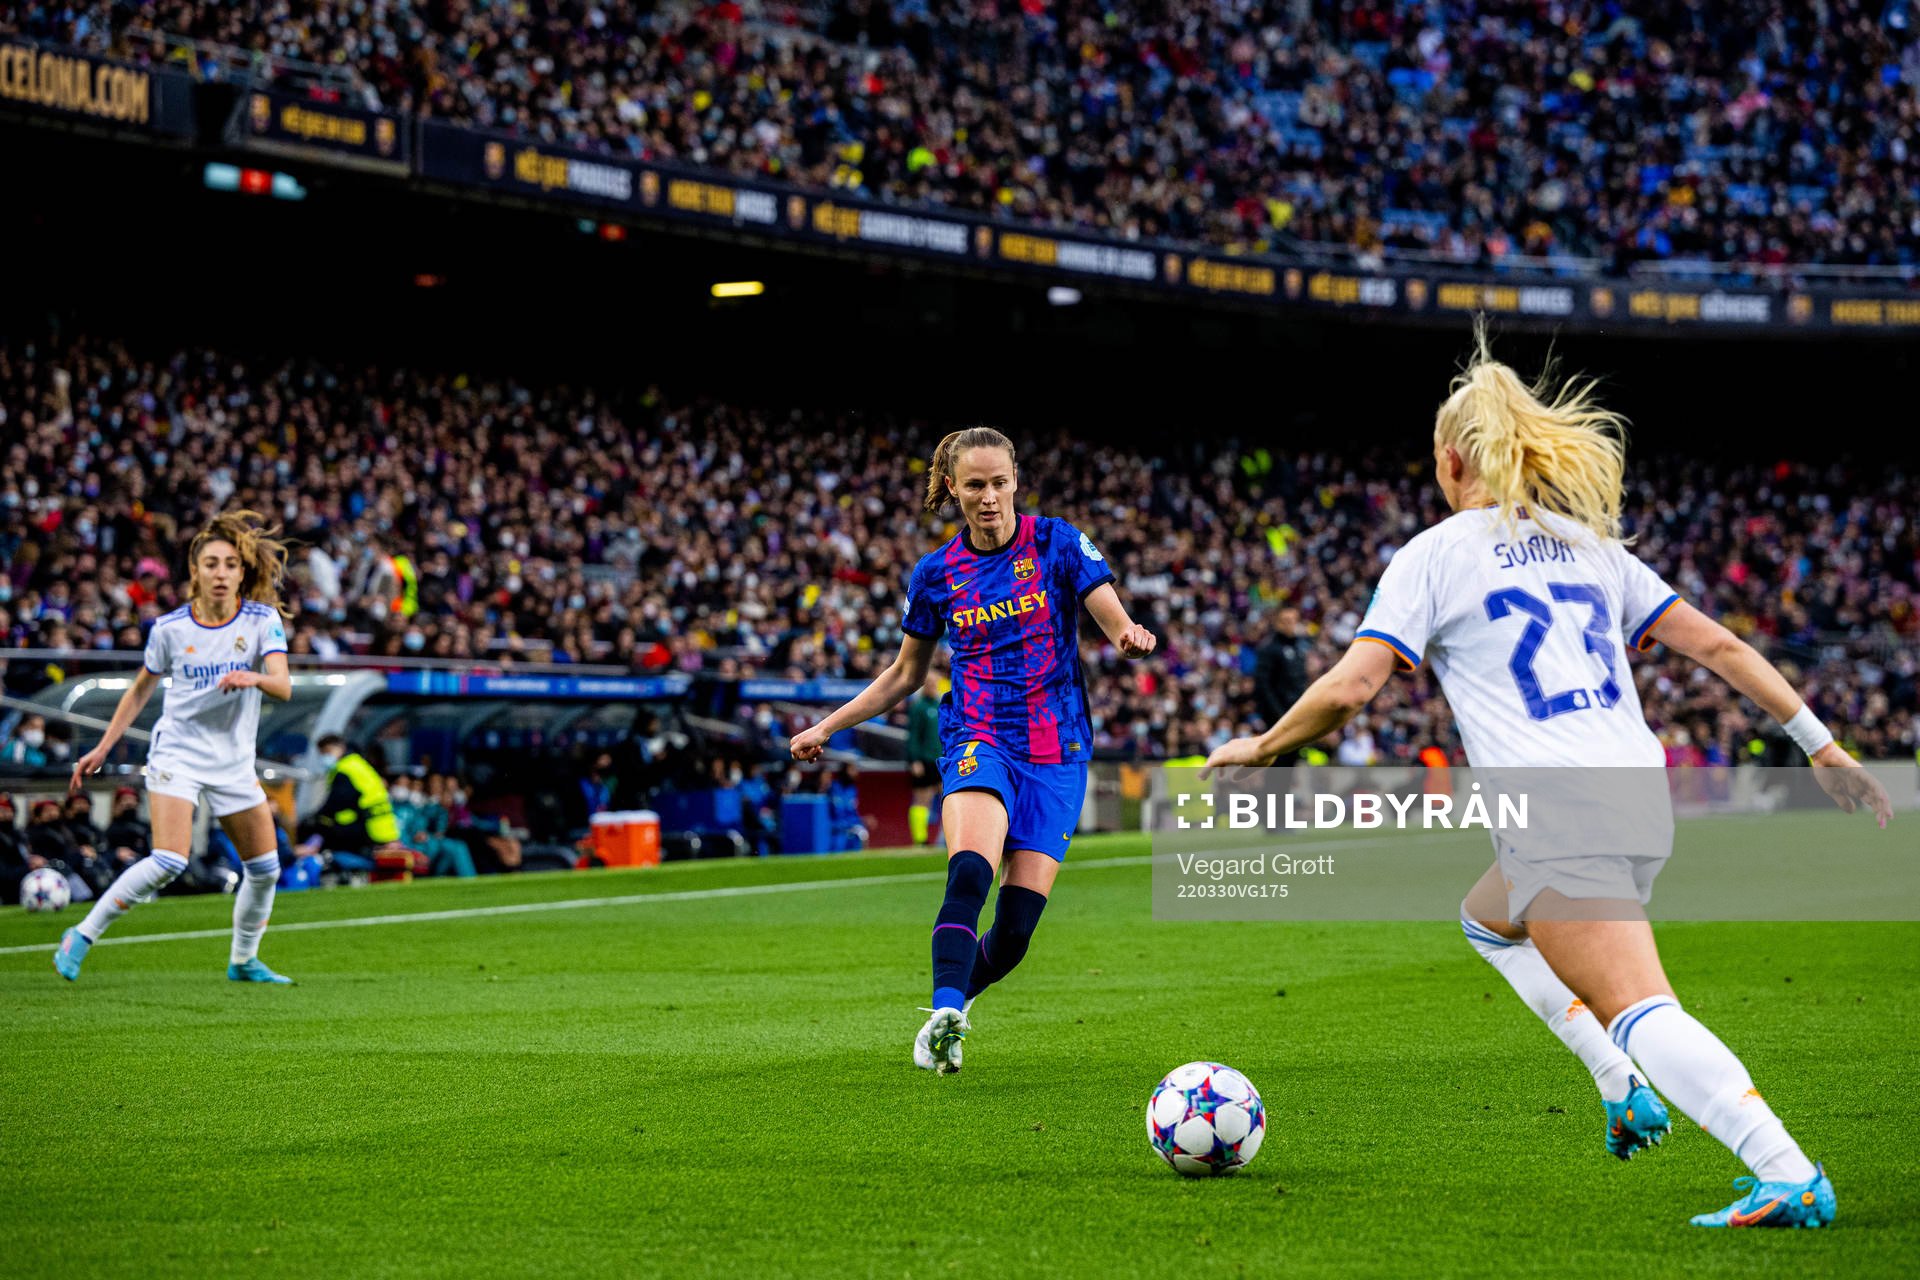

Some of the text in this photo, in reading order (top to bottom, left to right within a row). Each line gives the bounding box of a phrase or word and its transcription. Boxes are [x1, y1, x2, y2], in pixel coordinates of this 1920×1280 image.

[952, 590, 1047, 628] STANLEY
[1483, 581, 1622, 722] 23
[958, 741, 980, 757] 7
